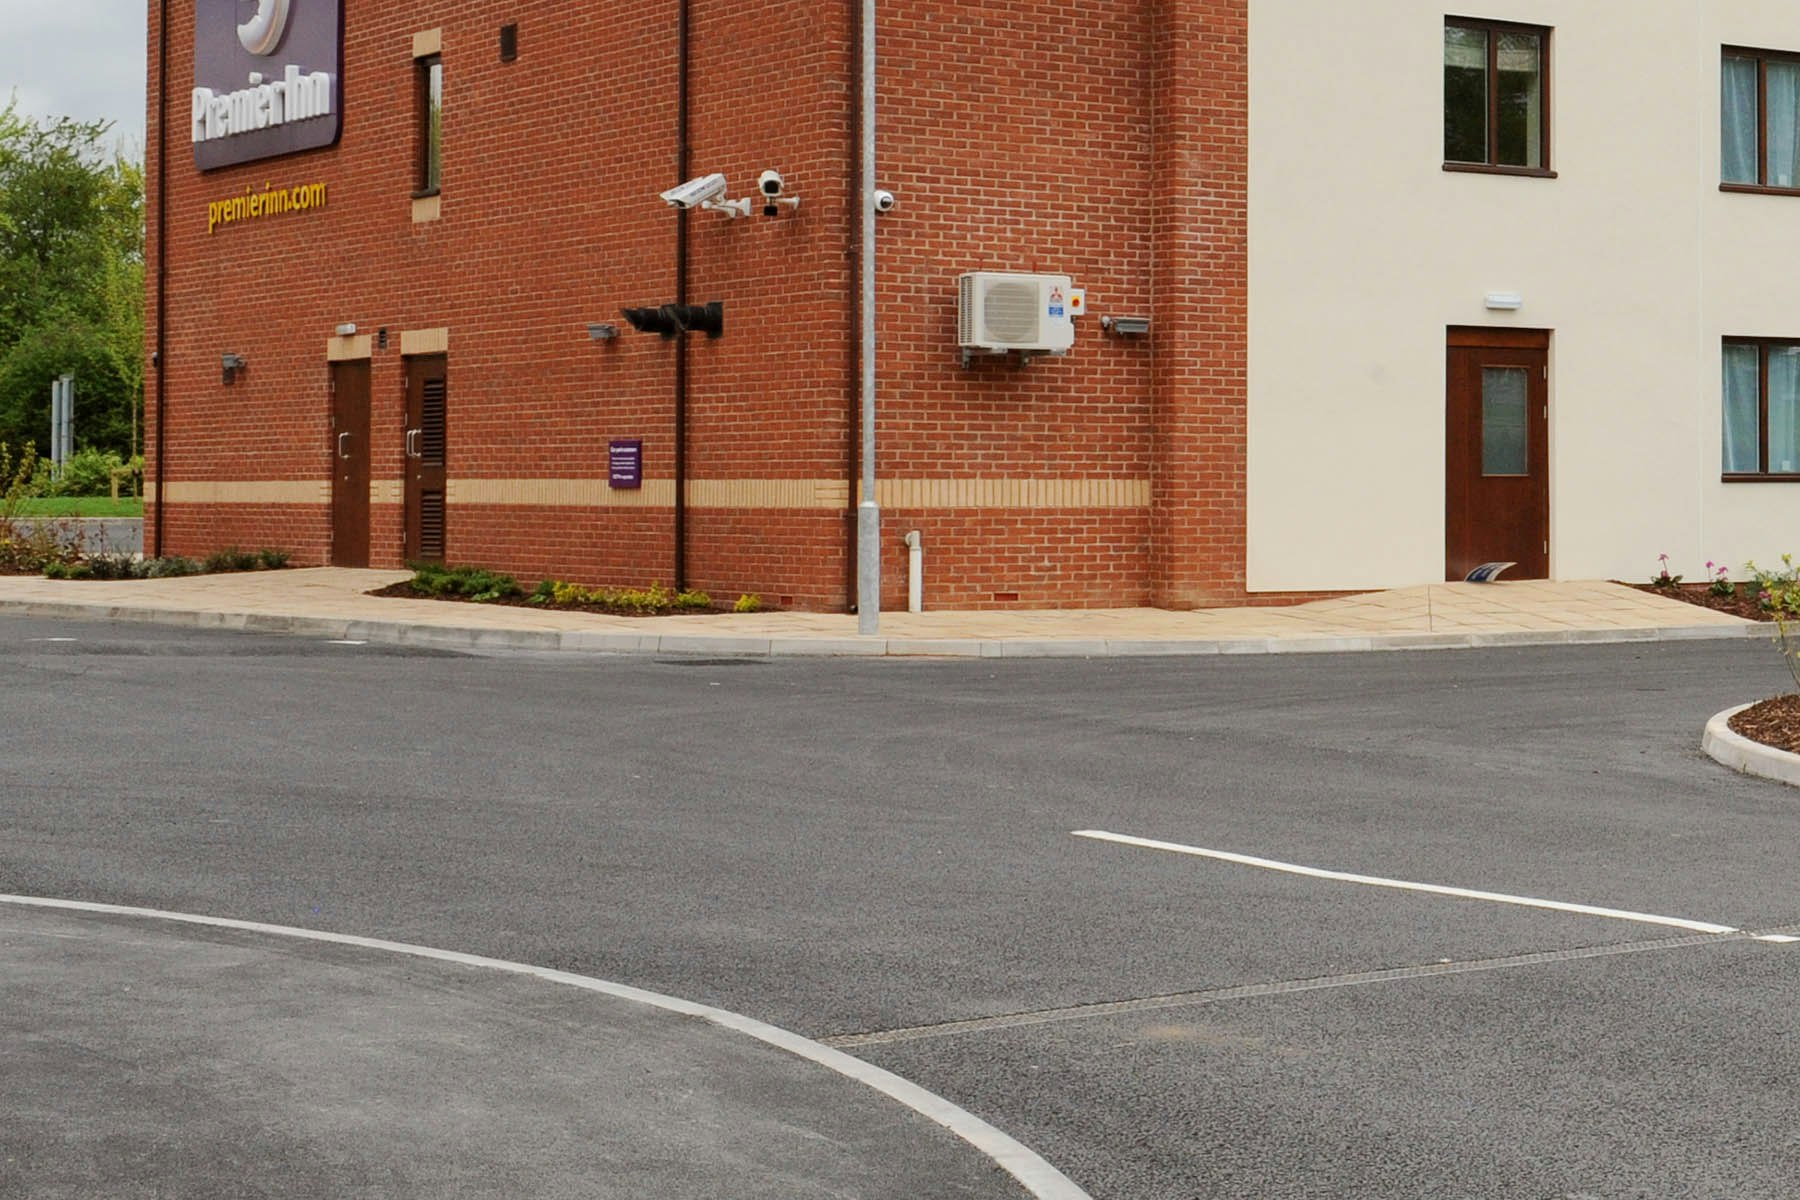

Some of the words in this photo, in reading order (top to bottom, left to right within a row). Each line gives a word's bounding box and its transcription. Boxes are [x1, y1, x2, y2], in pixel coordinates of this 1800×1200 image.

[191, 71, 287, 143] Premier
[284, 64, 331, 122] Inn
[208, 182, 326, 233] premierinn.com
